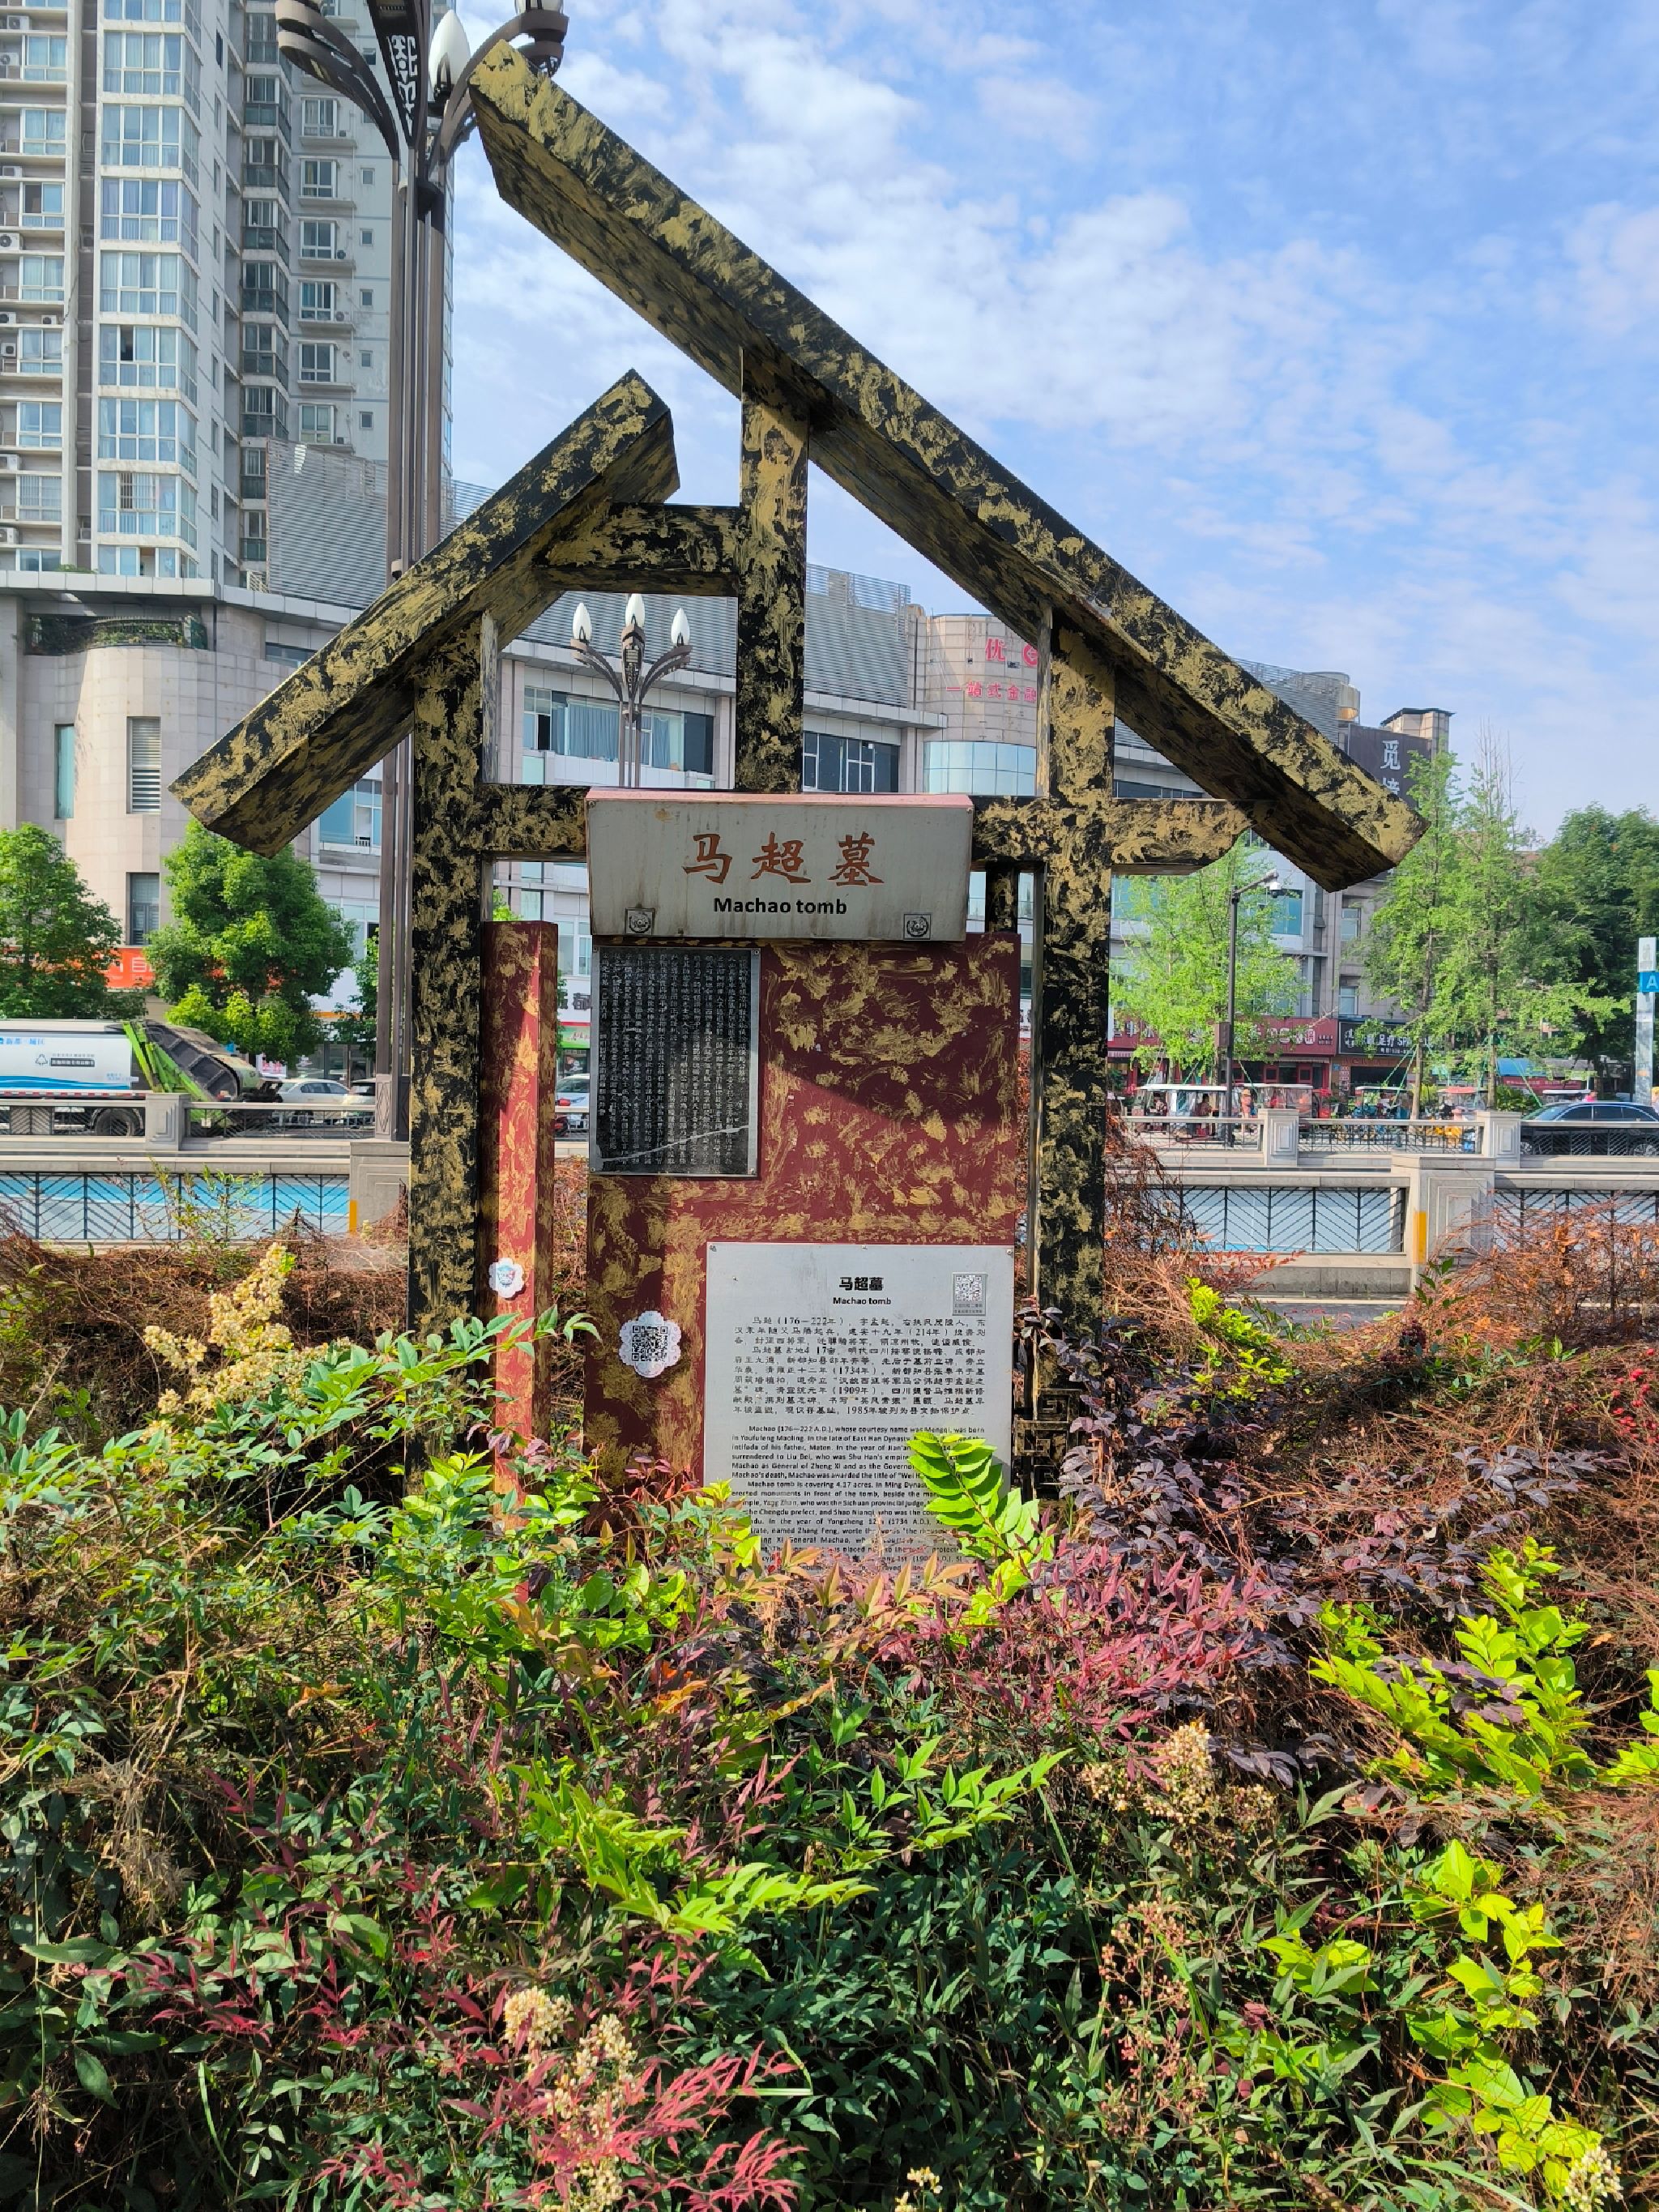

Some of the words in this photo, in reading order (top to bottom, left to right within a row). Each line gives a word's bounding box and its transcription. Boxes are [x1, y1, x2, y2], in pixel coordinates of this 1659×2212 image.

[682, 831, 884, 886] 马超墓
[714, 897, 791, 914] Machao
[795, 899, 847, 916] tomb
[838, 1276, 885, 1292] 马超墓
[832, 1296, 867, 1305] Machao
[868, 1296, 892, 1305] tomb
